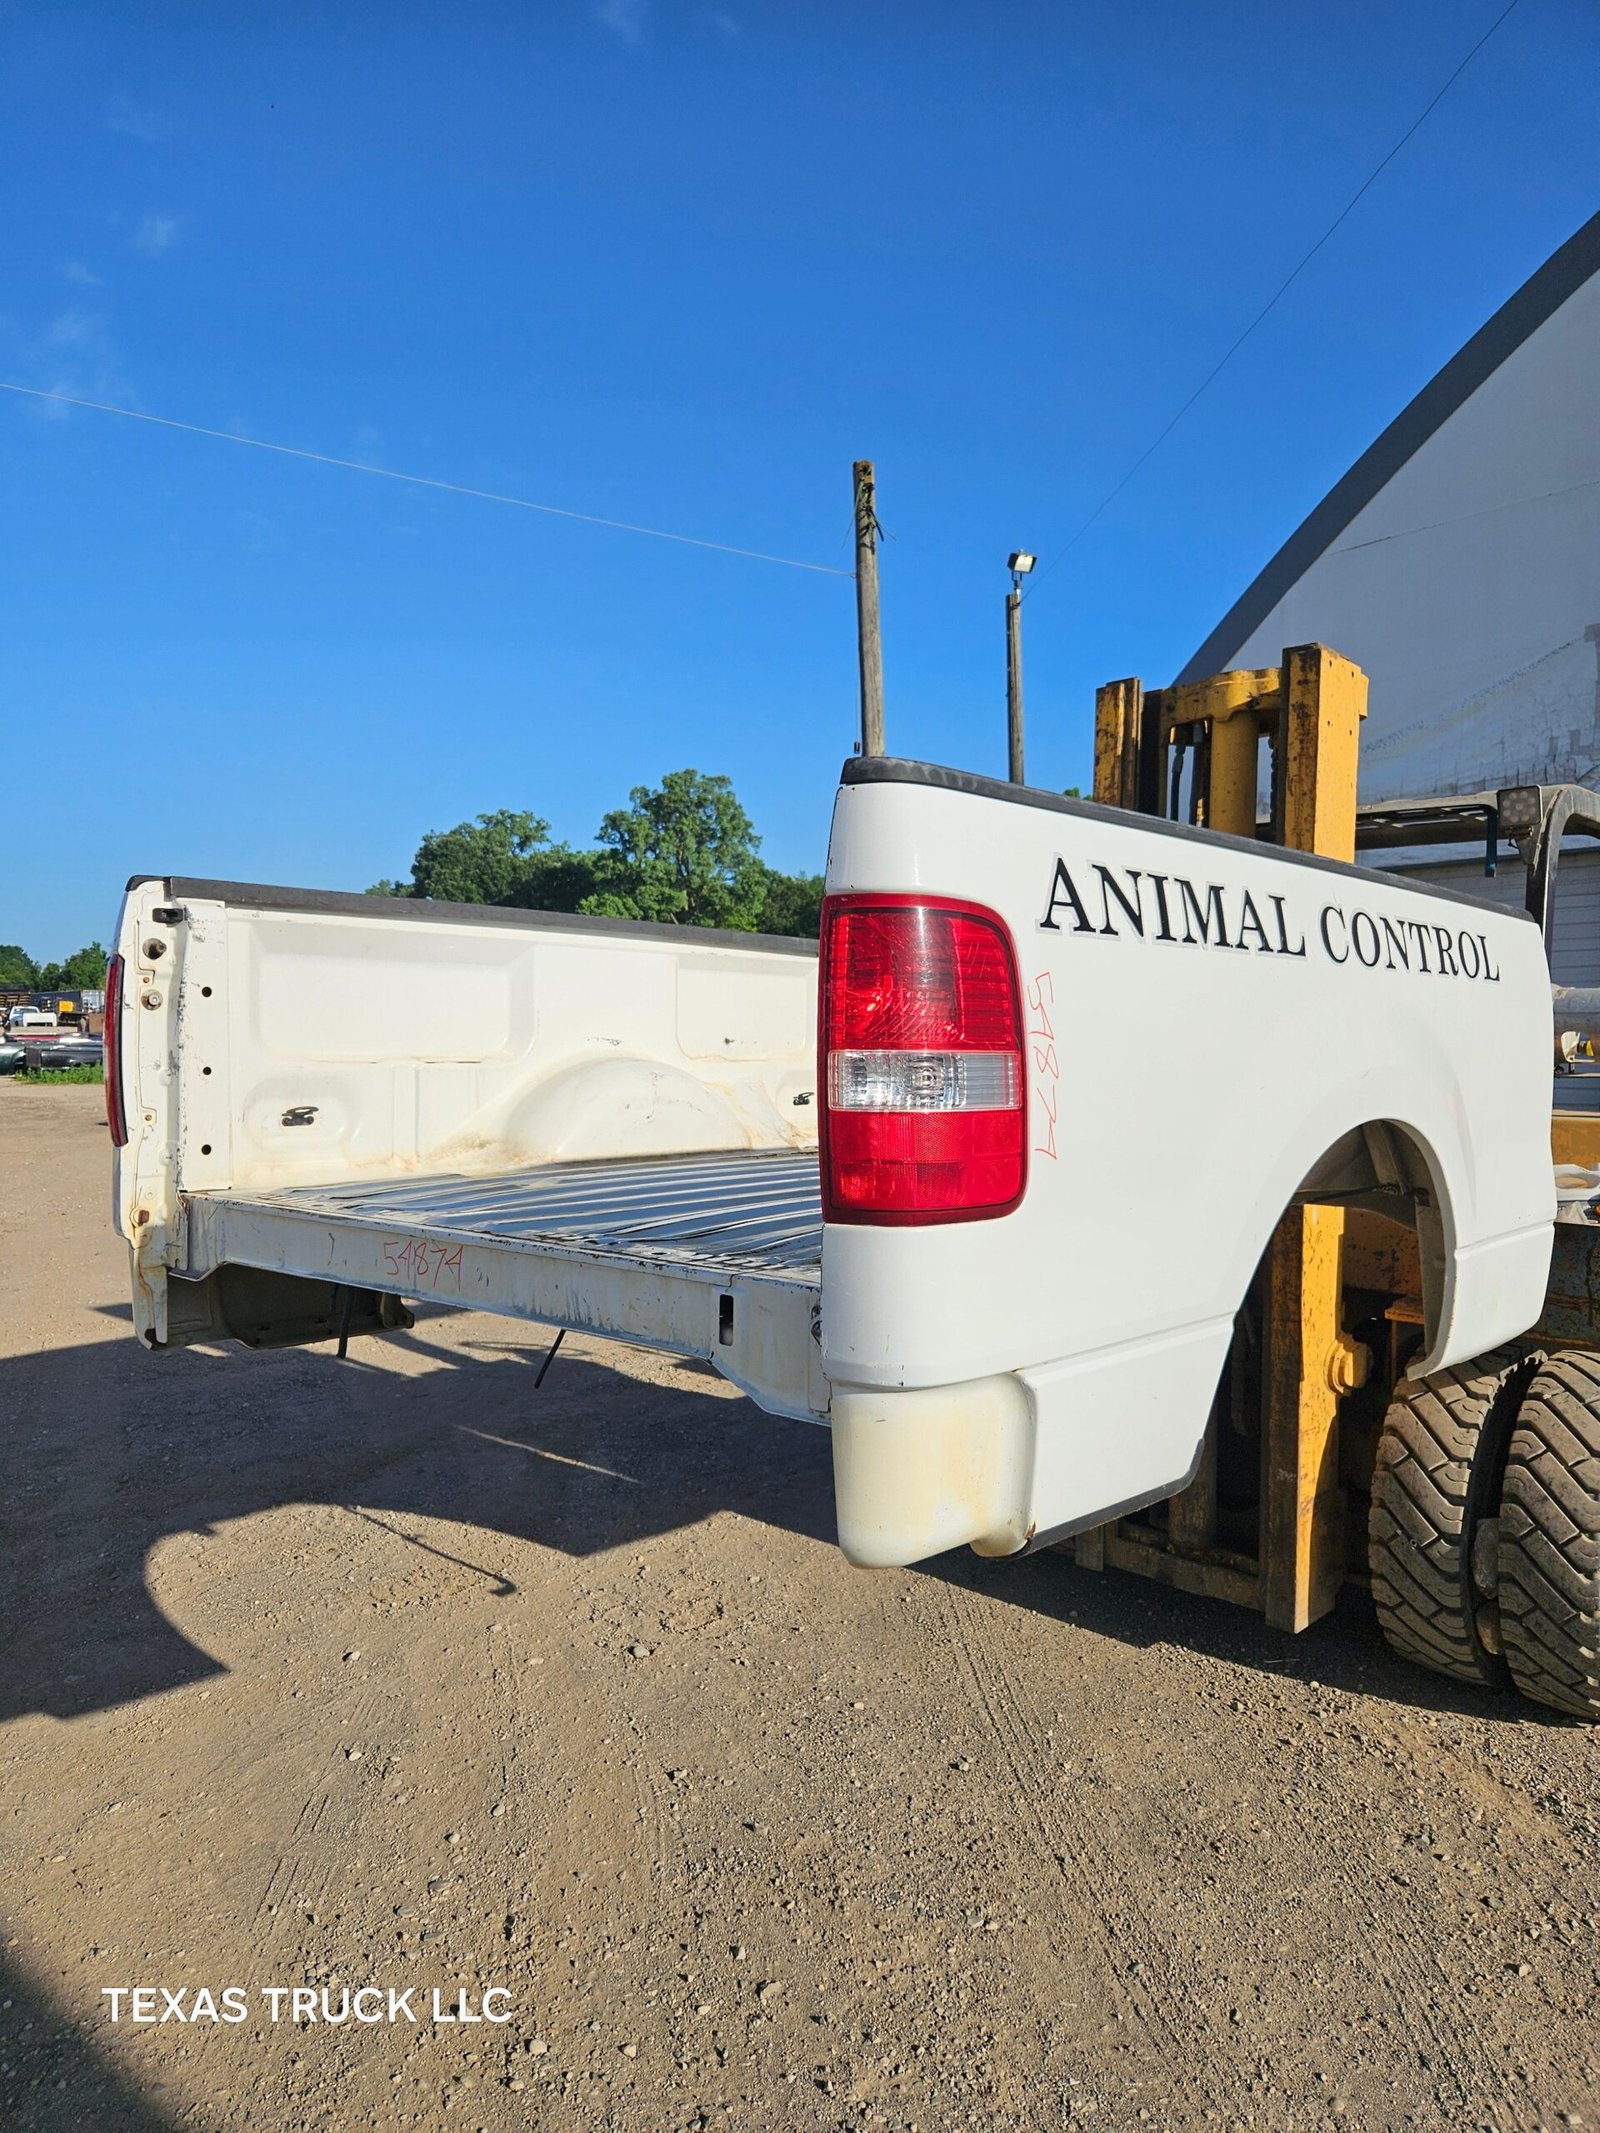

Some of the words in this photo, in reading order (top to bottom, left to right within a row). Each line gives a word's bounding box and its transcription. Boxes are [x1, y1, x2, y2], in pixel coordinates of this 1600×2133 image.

[1040, 857, 1306, 957] ANIMAL
[1320, 906, 1500, 982] CONTROL
[1027, 971, 1059, 1160] 54874
[383, 1240, 464, 1292] 54874
